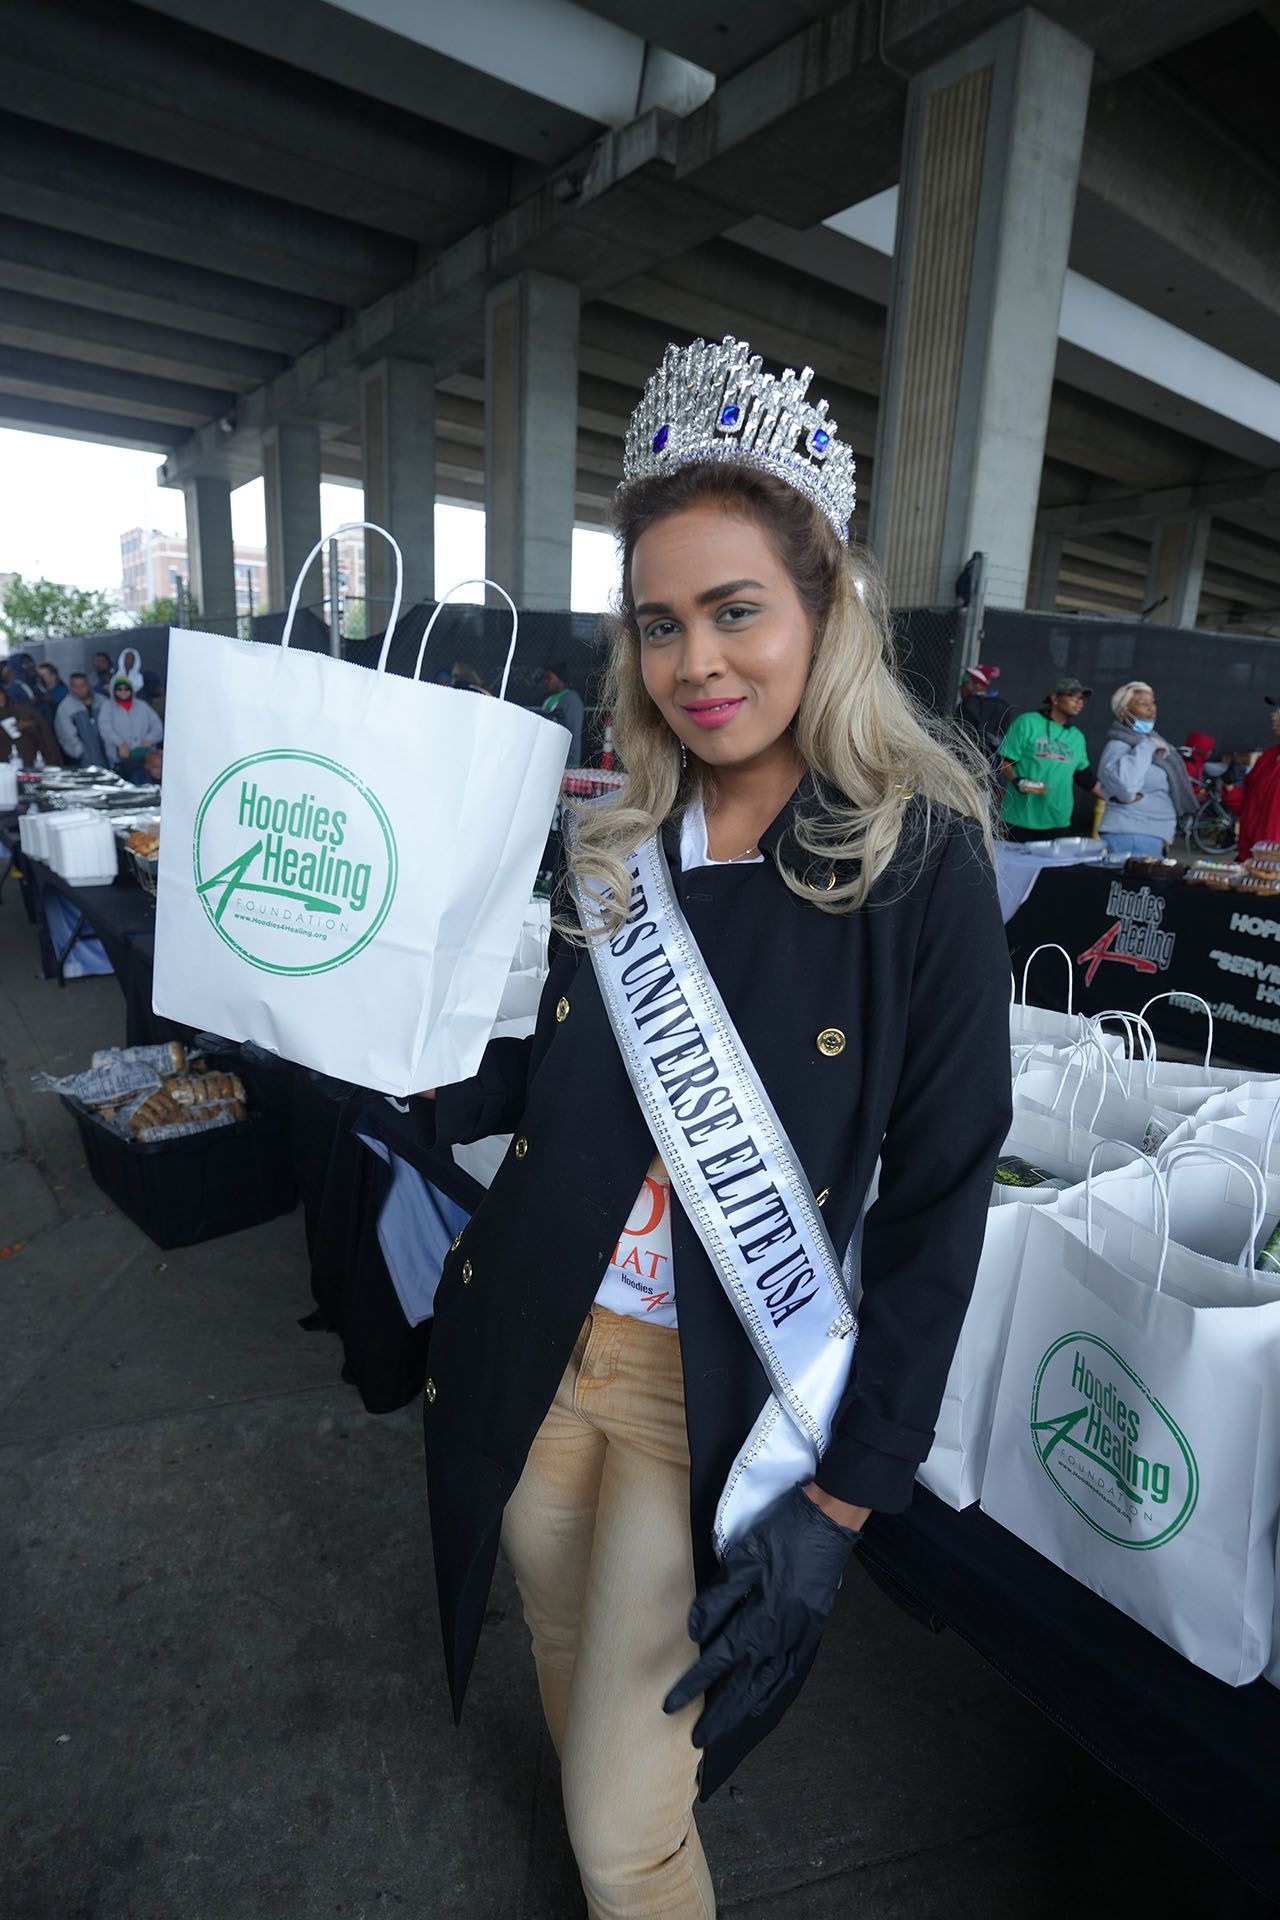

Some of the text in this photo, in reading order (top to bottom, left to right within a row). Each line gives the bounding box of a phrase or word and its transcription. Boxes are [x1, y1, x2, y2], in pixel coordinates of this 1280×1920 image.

[238, 781, 347, 846] Hoodies
[196, 833, 372, 925] 4 Healing
[1105, 880, 1166, 925] Hoodies
[234, 912, 328, 941] www.Hoodies4Healing.org
[236, 897, 350, 933] FOUNDATION
[1077, 919, 1176, 987] 4 Healing
[621, 943, 744, 1148] UNIVERSE
[698, 1134, 798, 1265] ELITE
[756, 1242, 821, 1329] USA
[621, 1273, 654, 1295] Hoodies
[1071, 1350, 1140, 1443] Hoodies
[1030, 1403, 1170, 1505] 4 Healing
[1061, 1448, 1153, 1522] FOUNDATION
